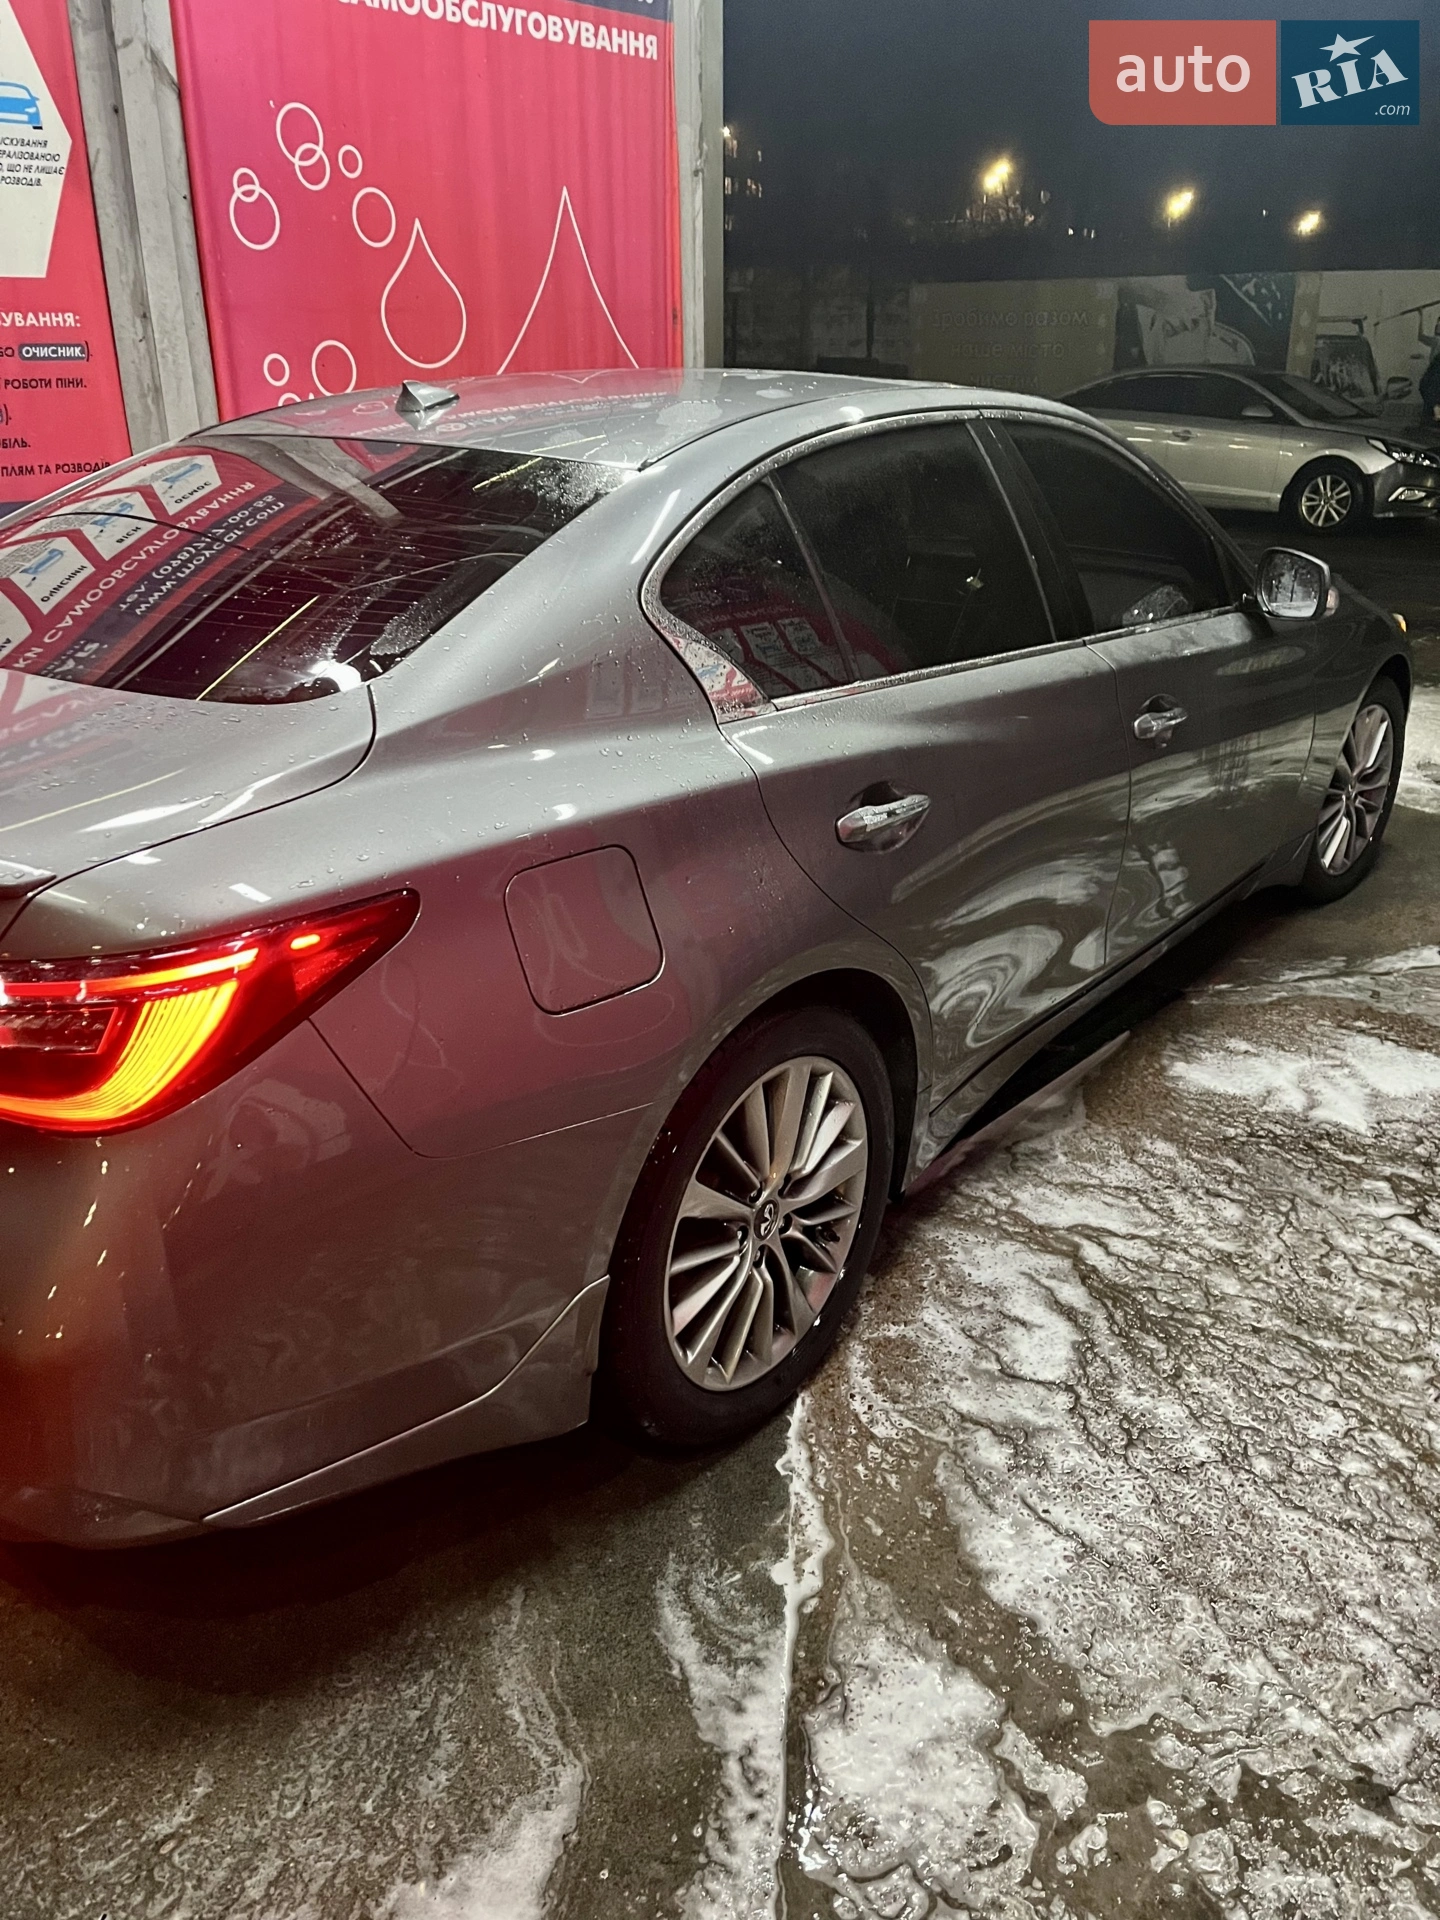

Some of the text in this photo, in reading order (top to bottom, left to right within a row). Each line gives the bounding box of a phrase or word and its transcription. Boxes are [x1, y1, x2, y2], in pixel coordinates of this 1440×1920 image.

[338, 0, 658, 60] ООБСЛУГОВУВАННЯ
[23, 164, 33, 173] НЕ
[0, 312, 81, 327] УВАННЯ:
[4, 378, 87, 389] РОБОТИ ПІНИ.
[0, 437, 31, 449] БІЛЬ.
[1, 465, 35, 477] ПЛЯМ
[37, 464, 51, 475] ТА
